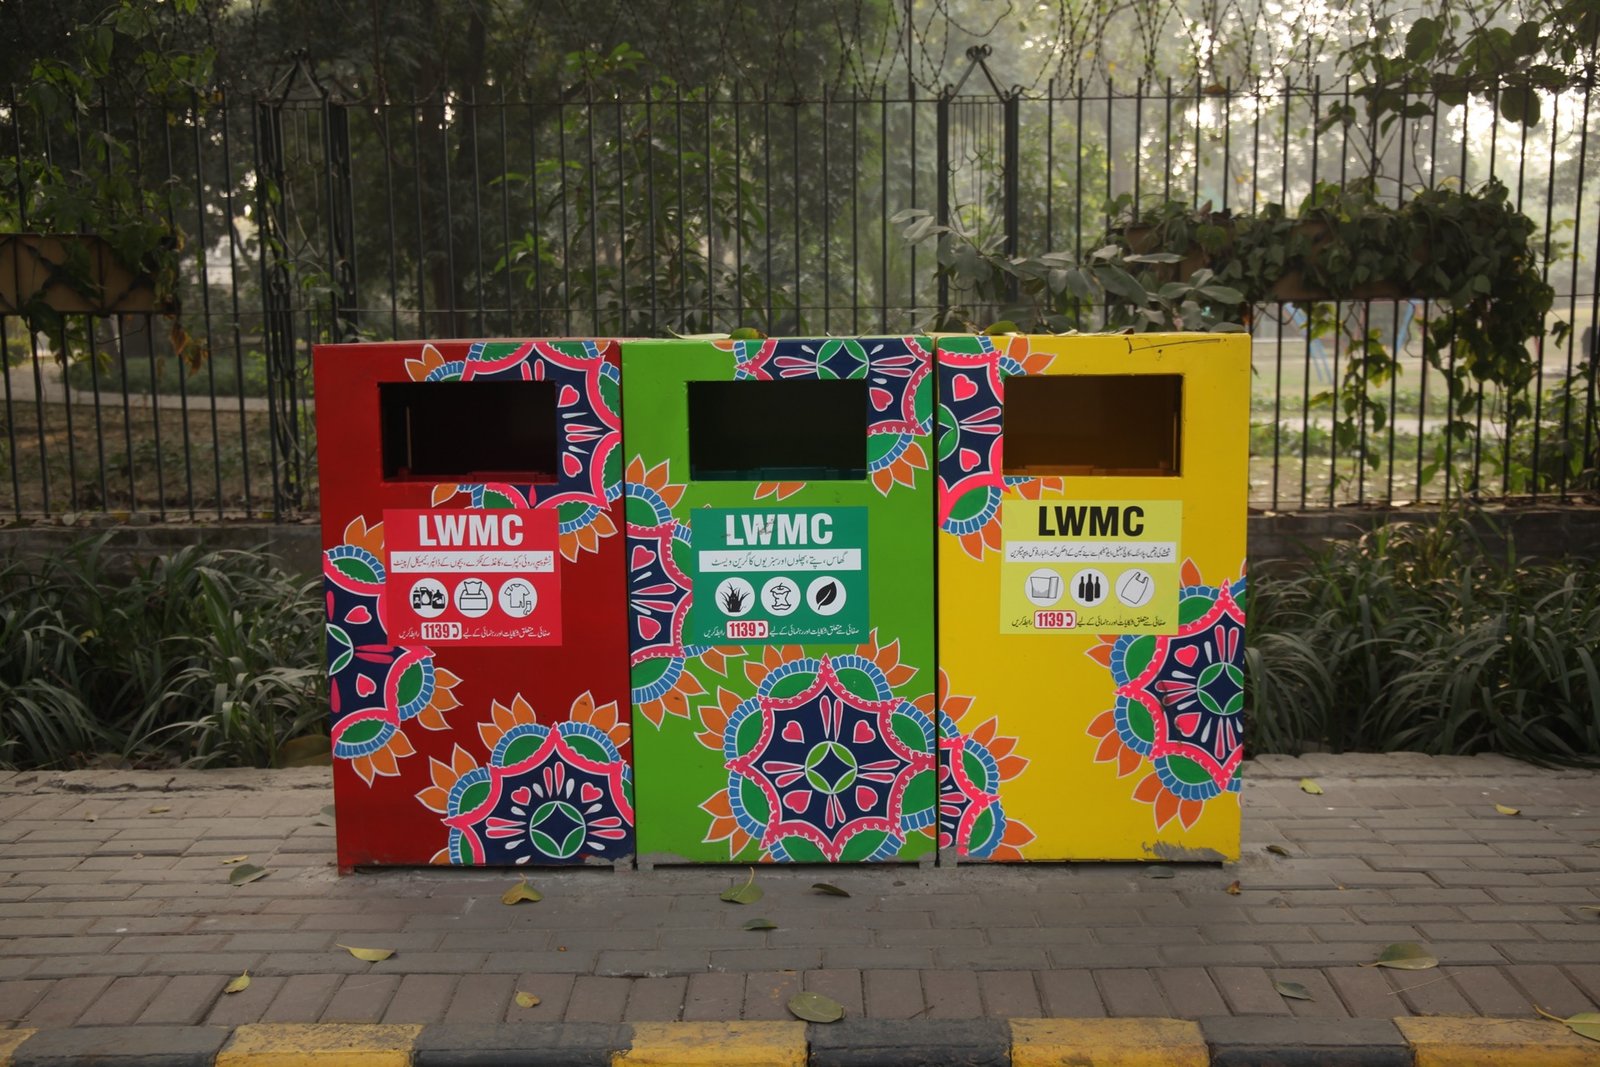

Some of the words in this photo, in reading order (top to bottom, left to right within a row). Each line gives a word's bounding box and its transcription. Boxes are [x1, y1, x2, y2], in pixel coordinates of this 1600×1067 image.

[1039, 505, 1144, 536] LWMC
[418, 514, 524, 546] LWMC
[725, 513, 833, 546] LWMC
[778, 557, 786, 565] اور
[1012, 616, 1026, 628] کریں
[1038, 612, 1063, 627] 1139
[1086, 616, 1094, 626] کے
[1152, 616, 1166, 627] صفائی
[398, 627, 414, 640] کریں
[424, 624, 450, 638] 1139
[472, 628, 480, 638] کے
[538, 626, 551, 638] صفائی
[704, 626, 718, 638] کریں
[730, 622, 756, 637] 1139
[779, 626, 787, 636] کے
[846, 624, 860, 636] صفائی
